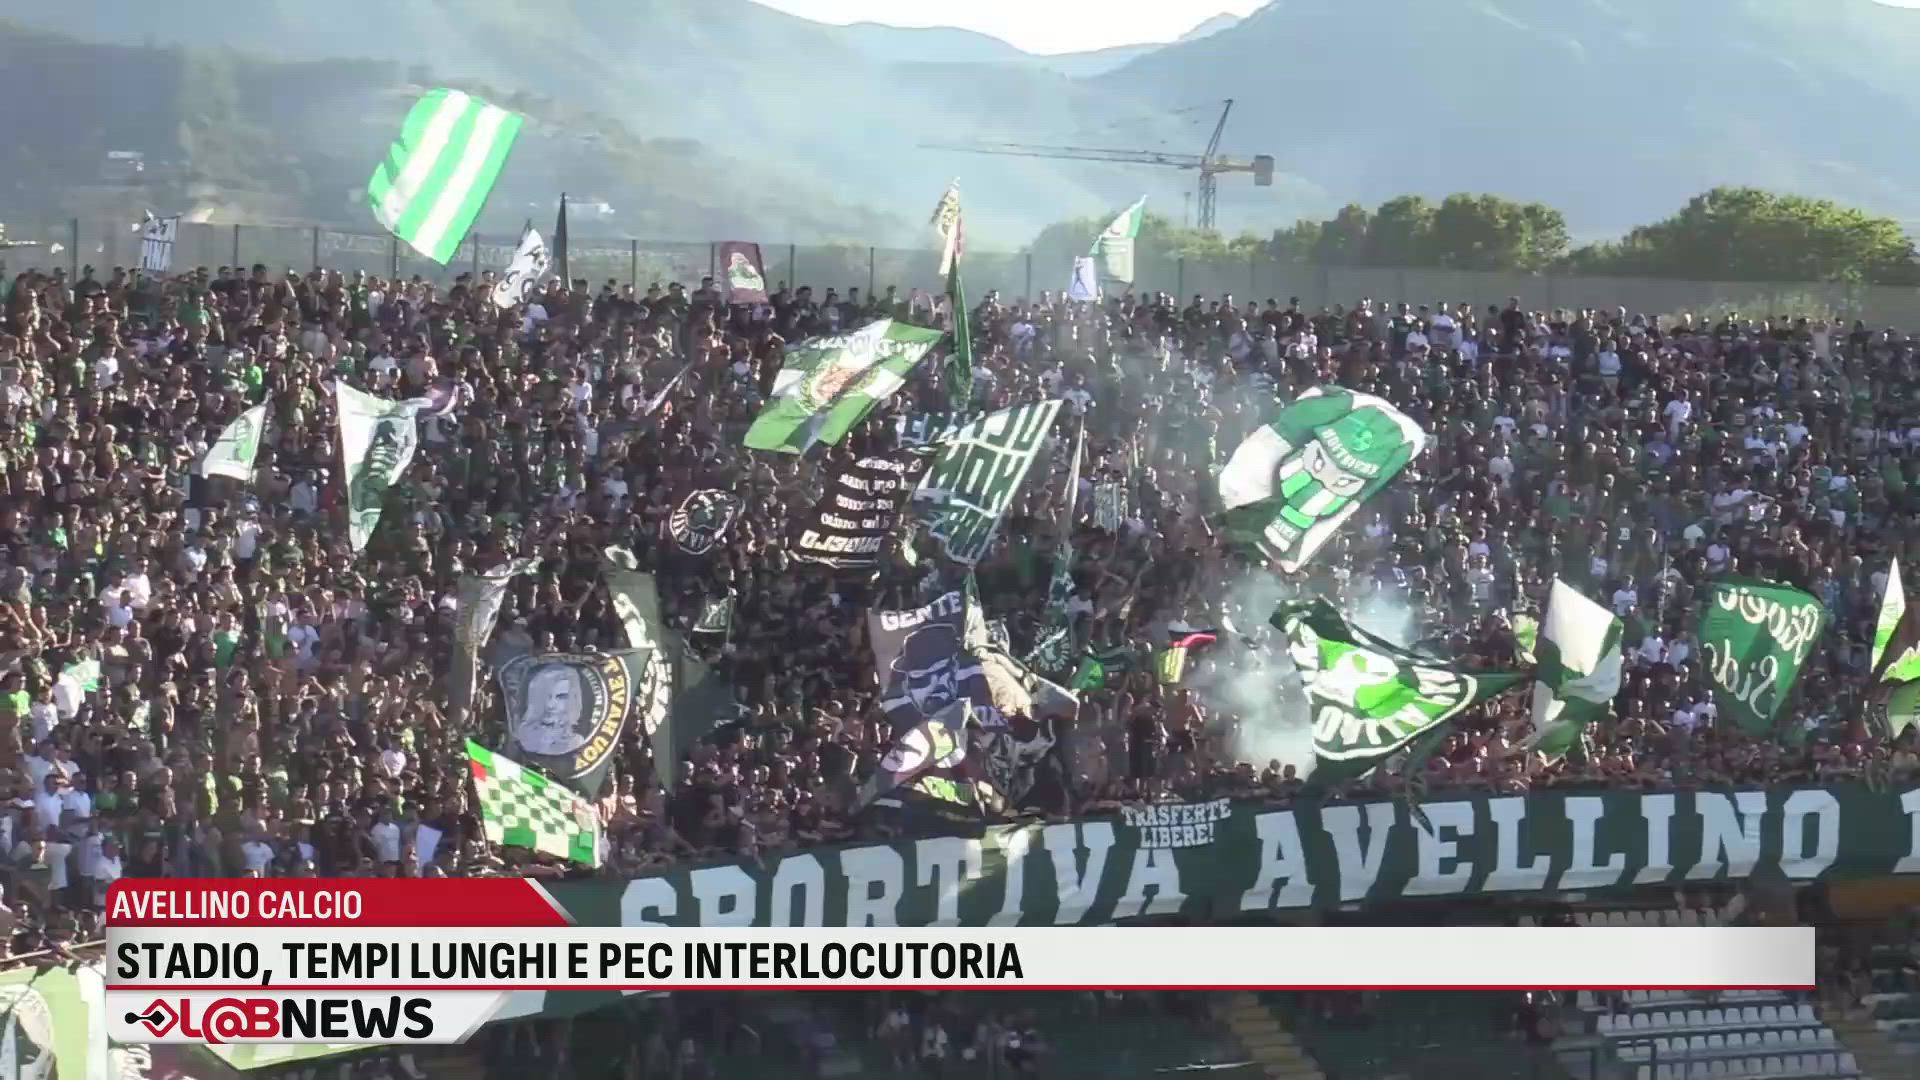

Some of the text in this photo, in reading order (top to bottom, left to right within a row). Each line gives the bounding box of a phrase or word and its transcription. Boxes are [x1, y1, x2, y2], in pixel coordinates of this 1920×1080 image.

[880, 590, 962, 632] GENTE
[1120, 797, 1232, 827] TRASFERTE
[1140, 821, 1215, 849] LIBERE!
[1240, 789, 1840, 910] AVELLINO
